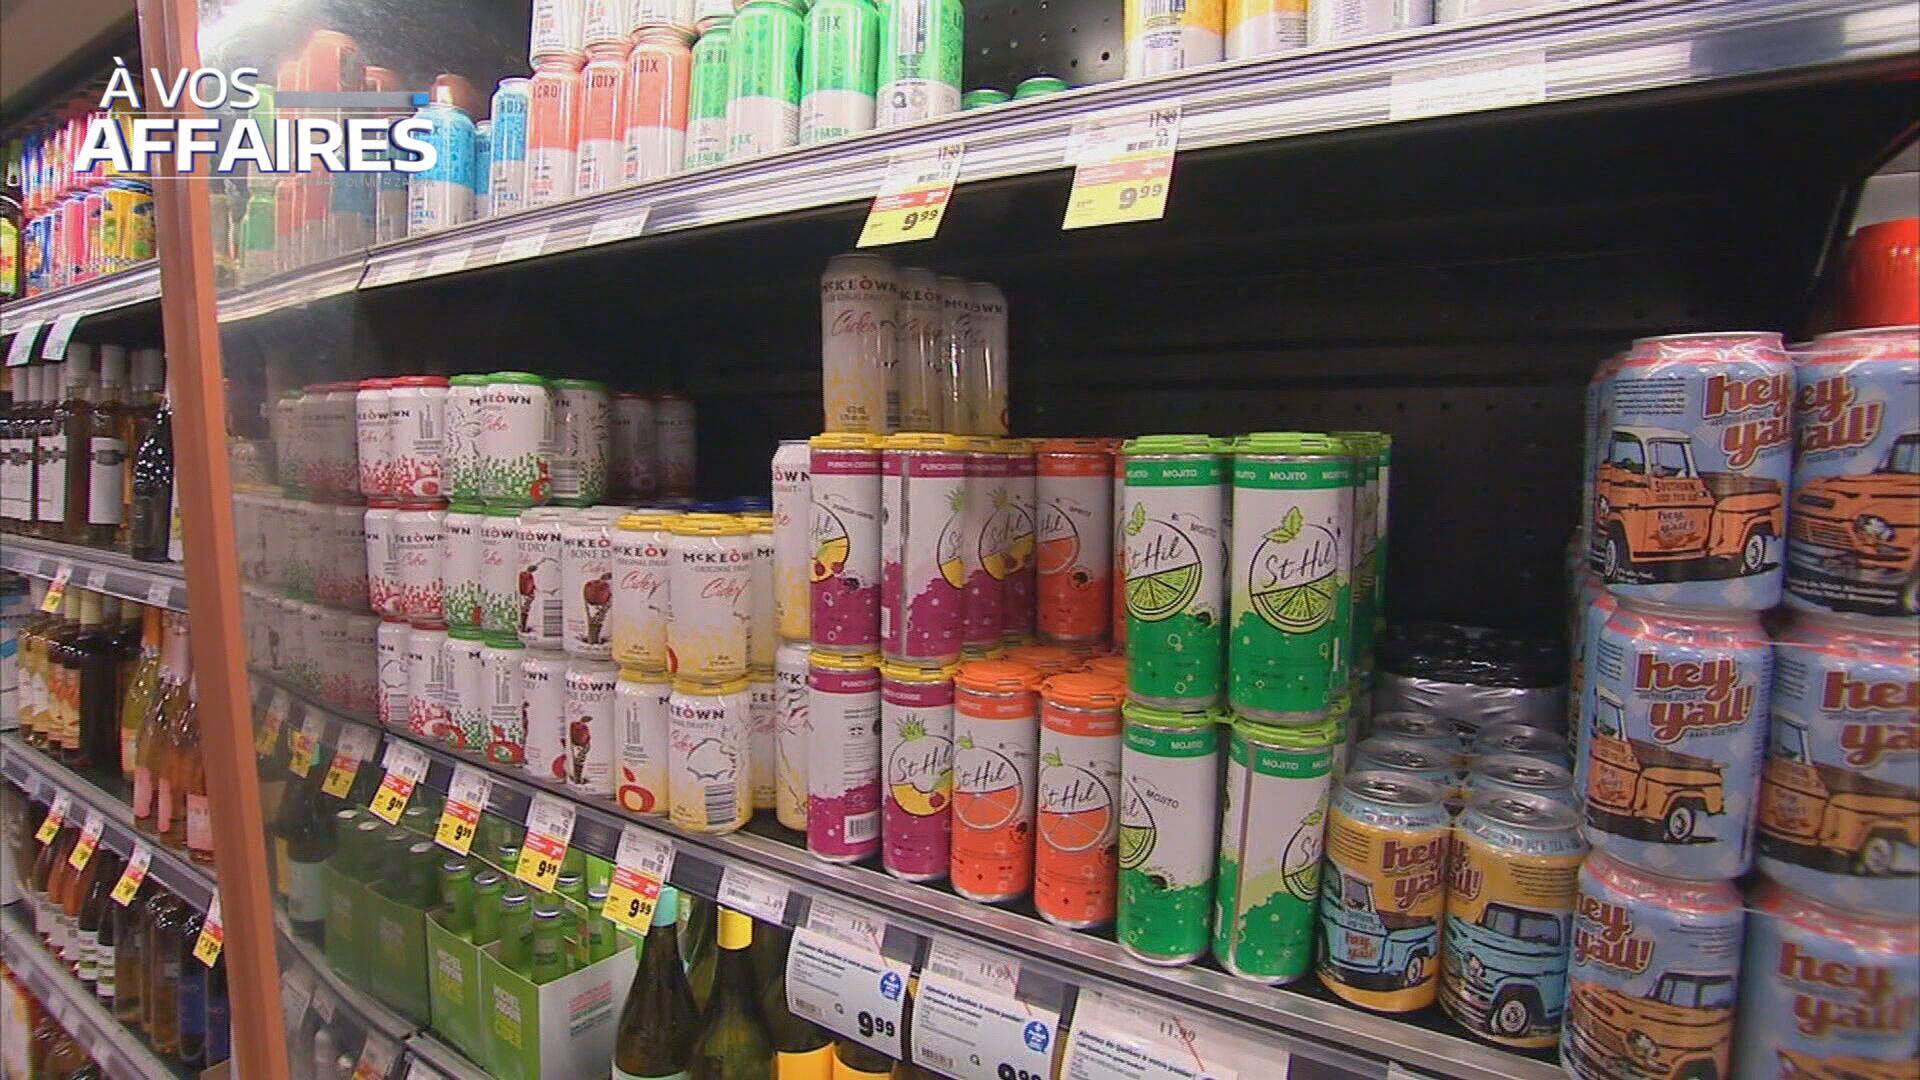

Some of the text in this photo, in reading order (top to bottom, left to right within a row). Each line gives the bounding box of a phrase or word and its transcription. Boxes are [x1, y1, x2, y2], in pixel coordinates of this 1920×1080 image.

[1162, 469, 1198, 479] MOJITO
[1269, 471, 1308, 480] MOJITO
[1262, 758, 1299, 770] MOJITO
[1145, 788, 1180, 810] MOJITO
